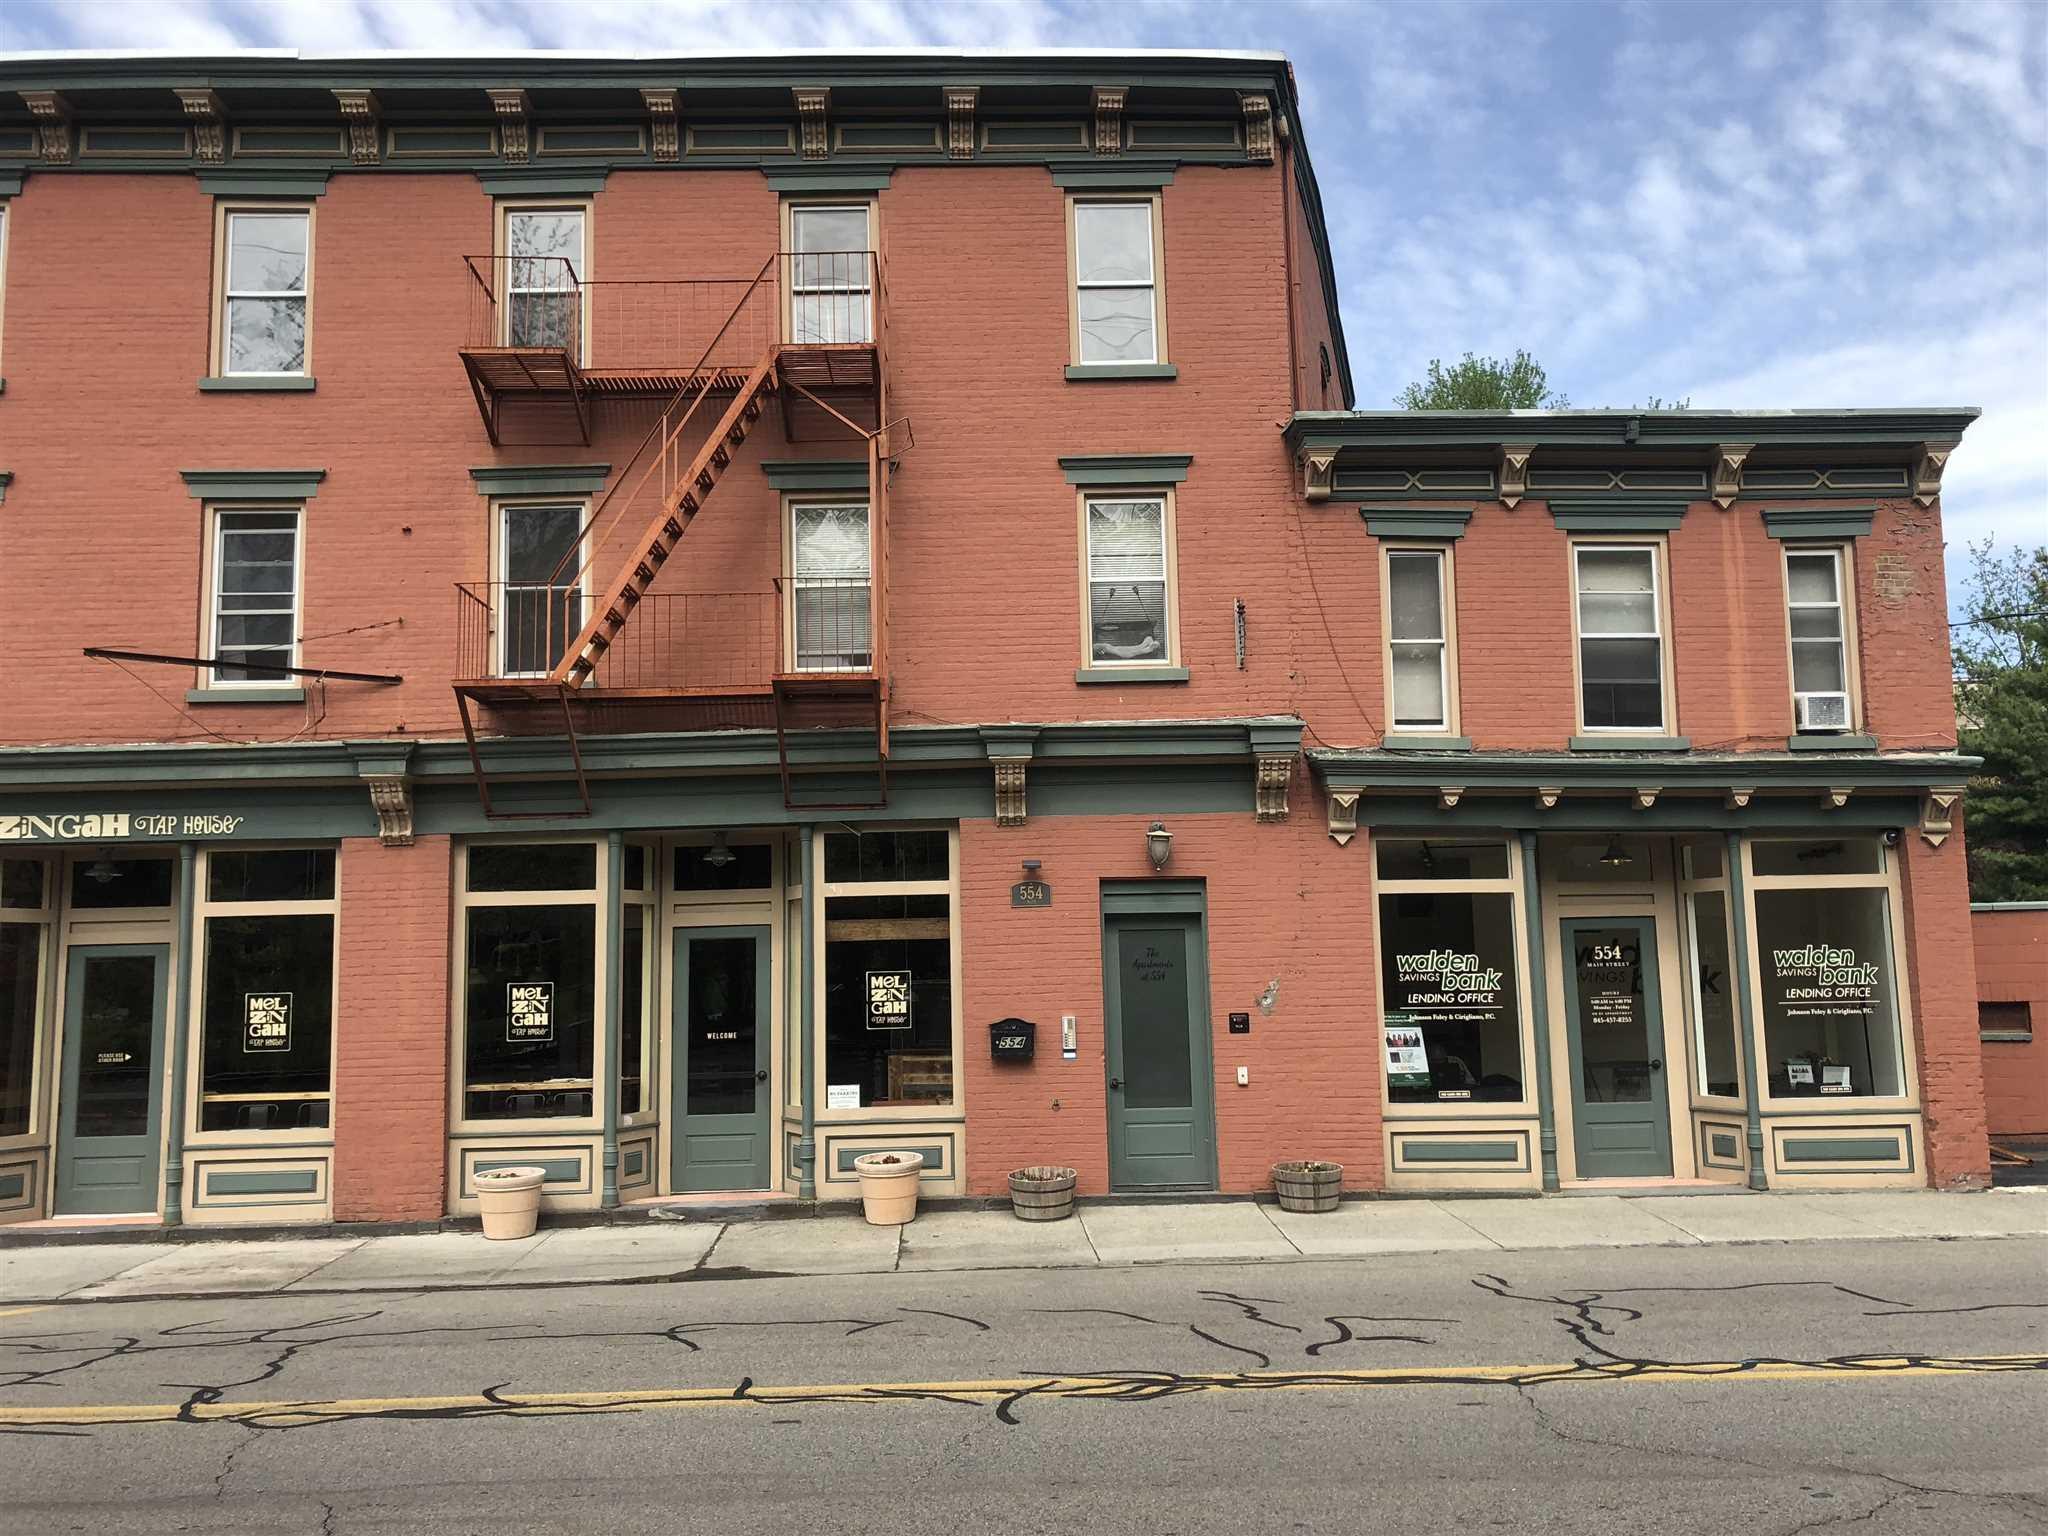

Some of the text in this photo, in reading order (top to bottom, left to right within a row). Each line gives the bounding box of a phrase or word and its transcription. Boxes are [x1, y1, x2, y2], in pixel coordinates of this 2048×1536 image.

[1020, 886, 1043, 900] 554
[1594, 945, 1622, 960] 554
[1773, 944, 1855, 967] walden
[1396, 950, 1479, 972] walden
[1399, 968, 1503, 991] SAVINGS bank
[1776, 962, 1880, 986] SAVINGS bank
[1408, 993, 1495, 1004] LENDING OFFICE
[1786, 987, 1871, 999] LENDING OFFICE
[1001, 1037, 1025, 1048] 554
